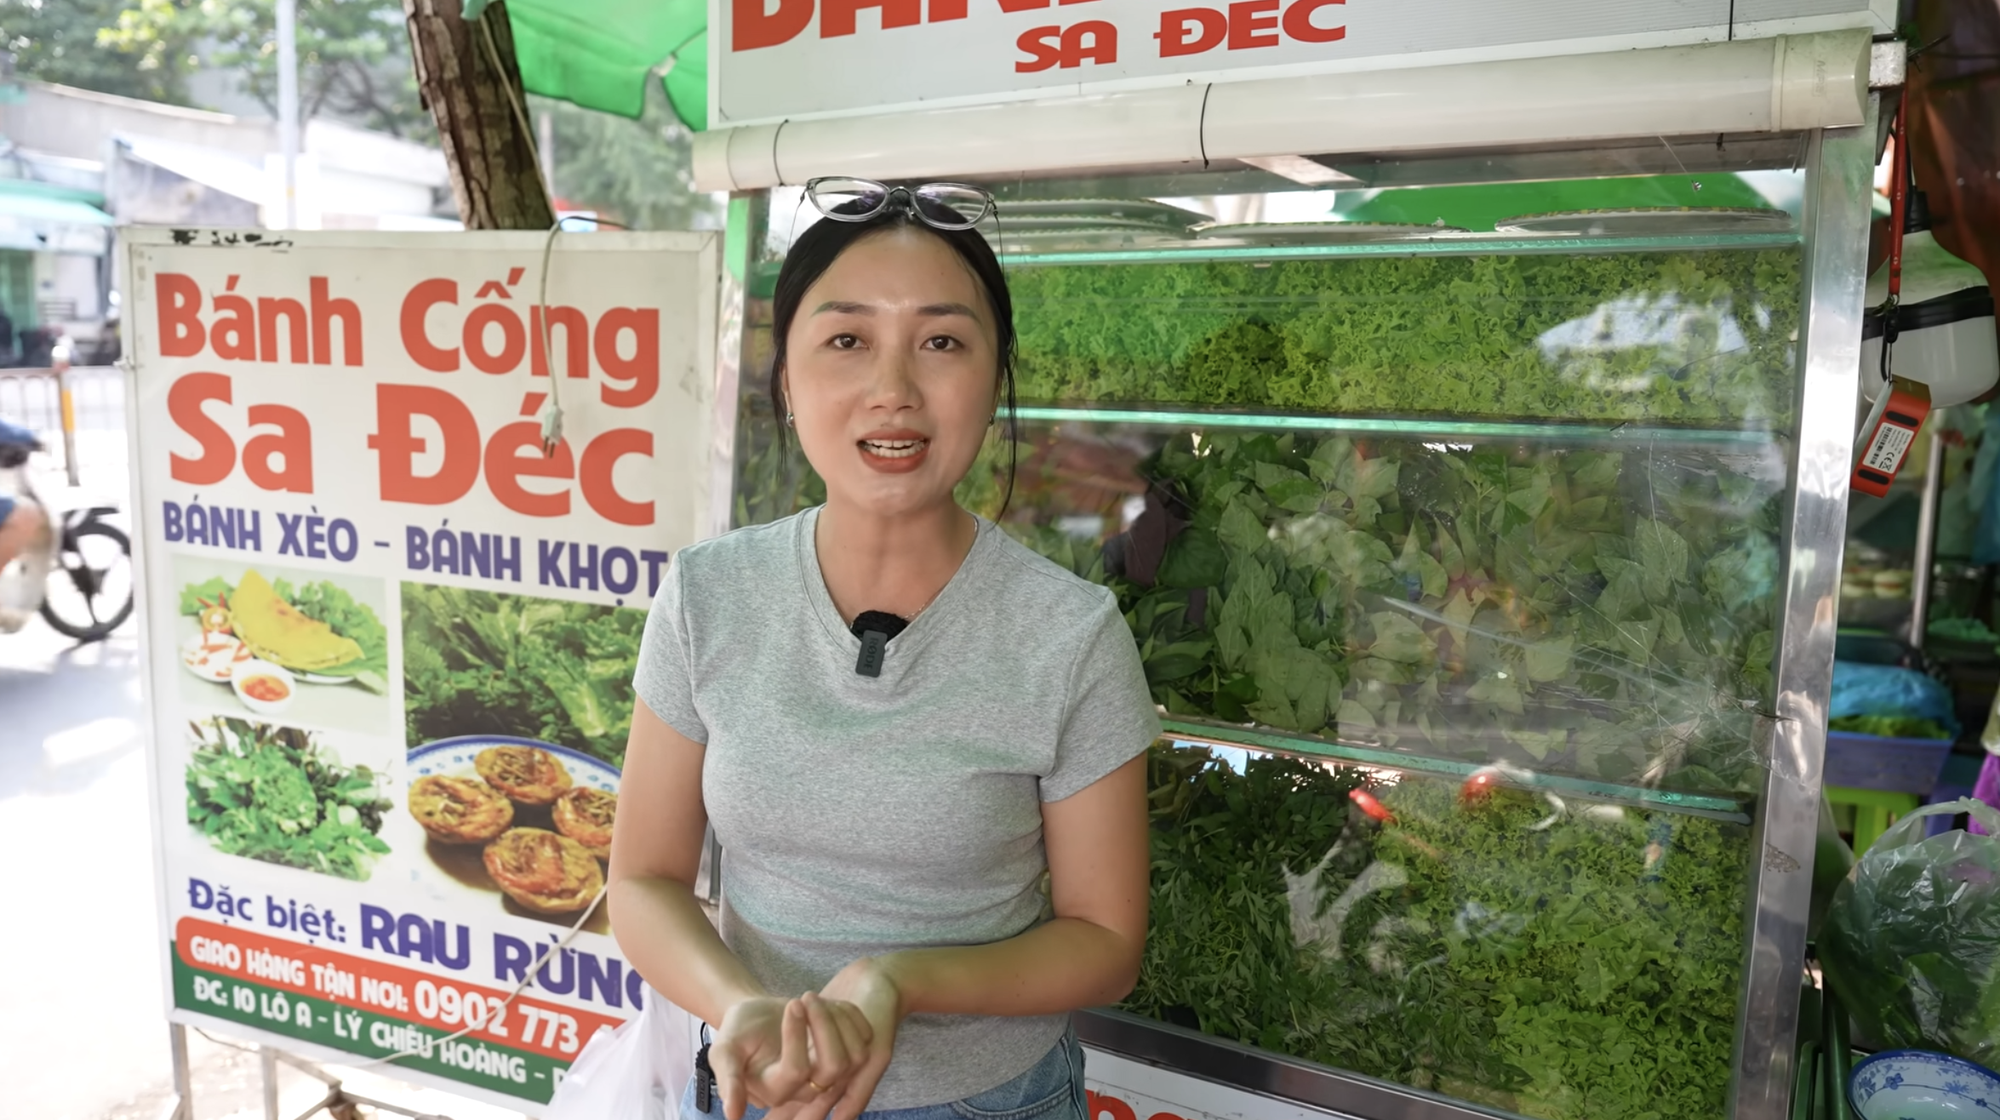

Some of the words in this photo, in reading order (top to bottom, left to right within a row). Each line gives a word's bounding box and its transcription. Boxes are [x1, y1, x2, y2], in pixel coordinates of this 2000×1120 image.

[1015, 20, 1117, 74] SA
[156, 272, 363, 367] Bánh
[400, 266, 659, 408] Cống
[168, 372, 313, 494] Sa
[367, 382, 654, 526] Đéc
[163, 495, 261, 552] BÁNH
[277, 505, 358, 562] XÈO
[406, 519, 521, 582] BÁNH
[537, 540, 668, 607] KHỌT
[188, 877, 253, 926] Đặc
[266, 895, 347, 944] biệt:
[360, 903, 470, 971] RAU
[190, 934, 242, 971] GIAO
[245, 947, 306, 987] HÀNG
[310, 961, 356, 1001] TẬN
[414, 979, 509, 1038] 0902
[518, 1003, 579, 1054] 773
[193, 975, 228, 1006] ĐC:
[260, 991, 290, 1023] LÔ
[295, 1001, 313, 1029] A
[333, 1009, 363, 1041] LÝ
[440, 1041, 527, 1084] HOÀNG
